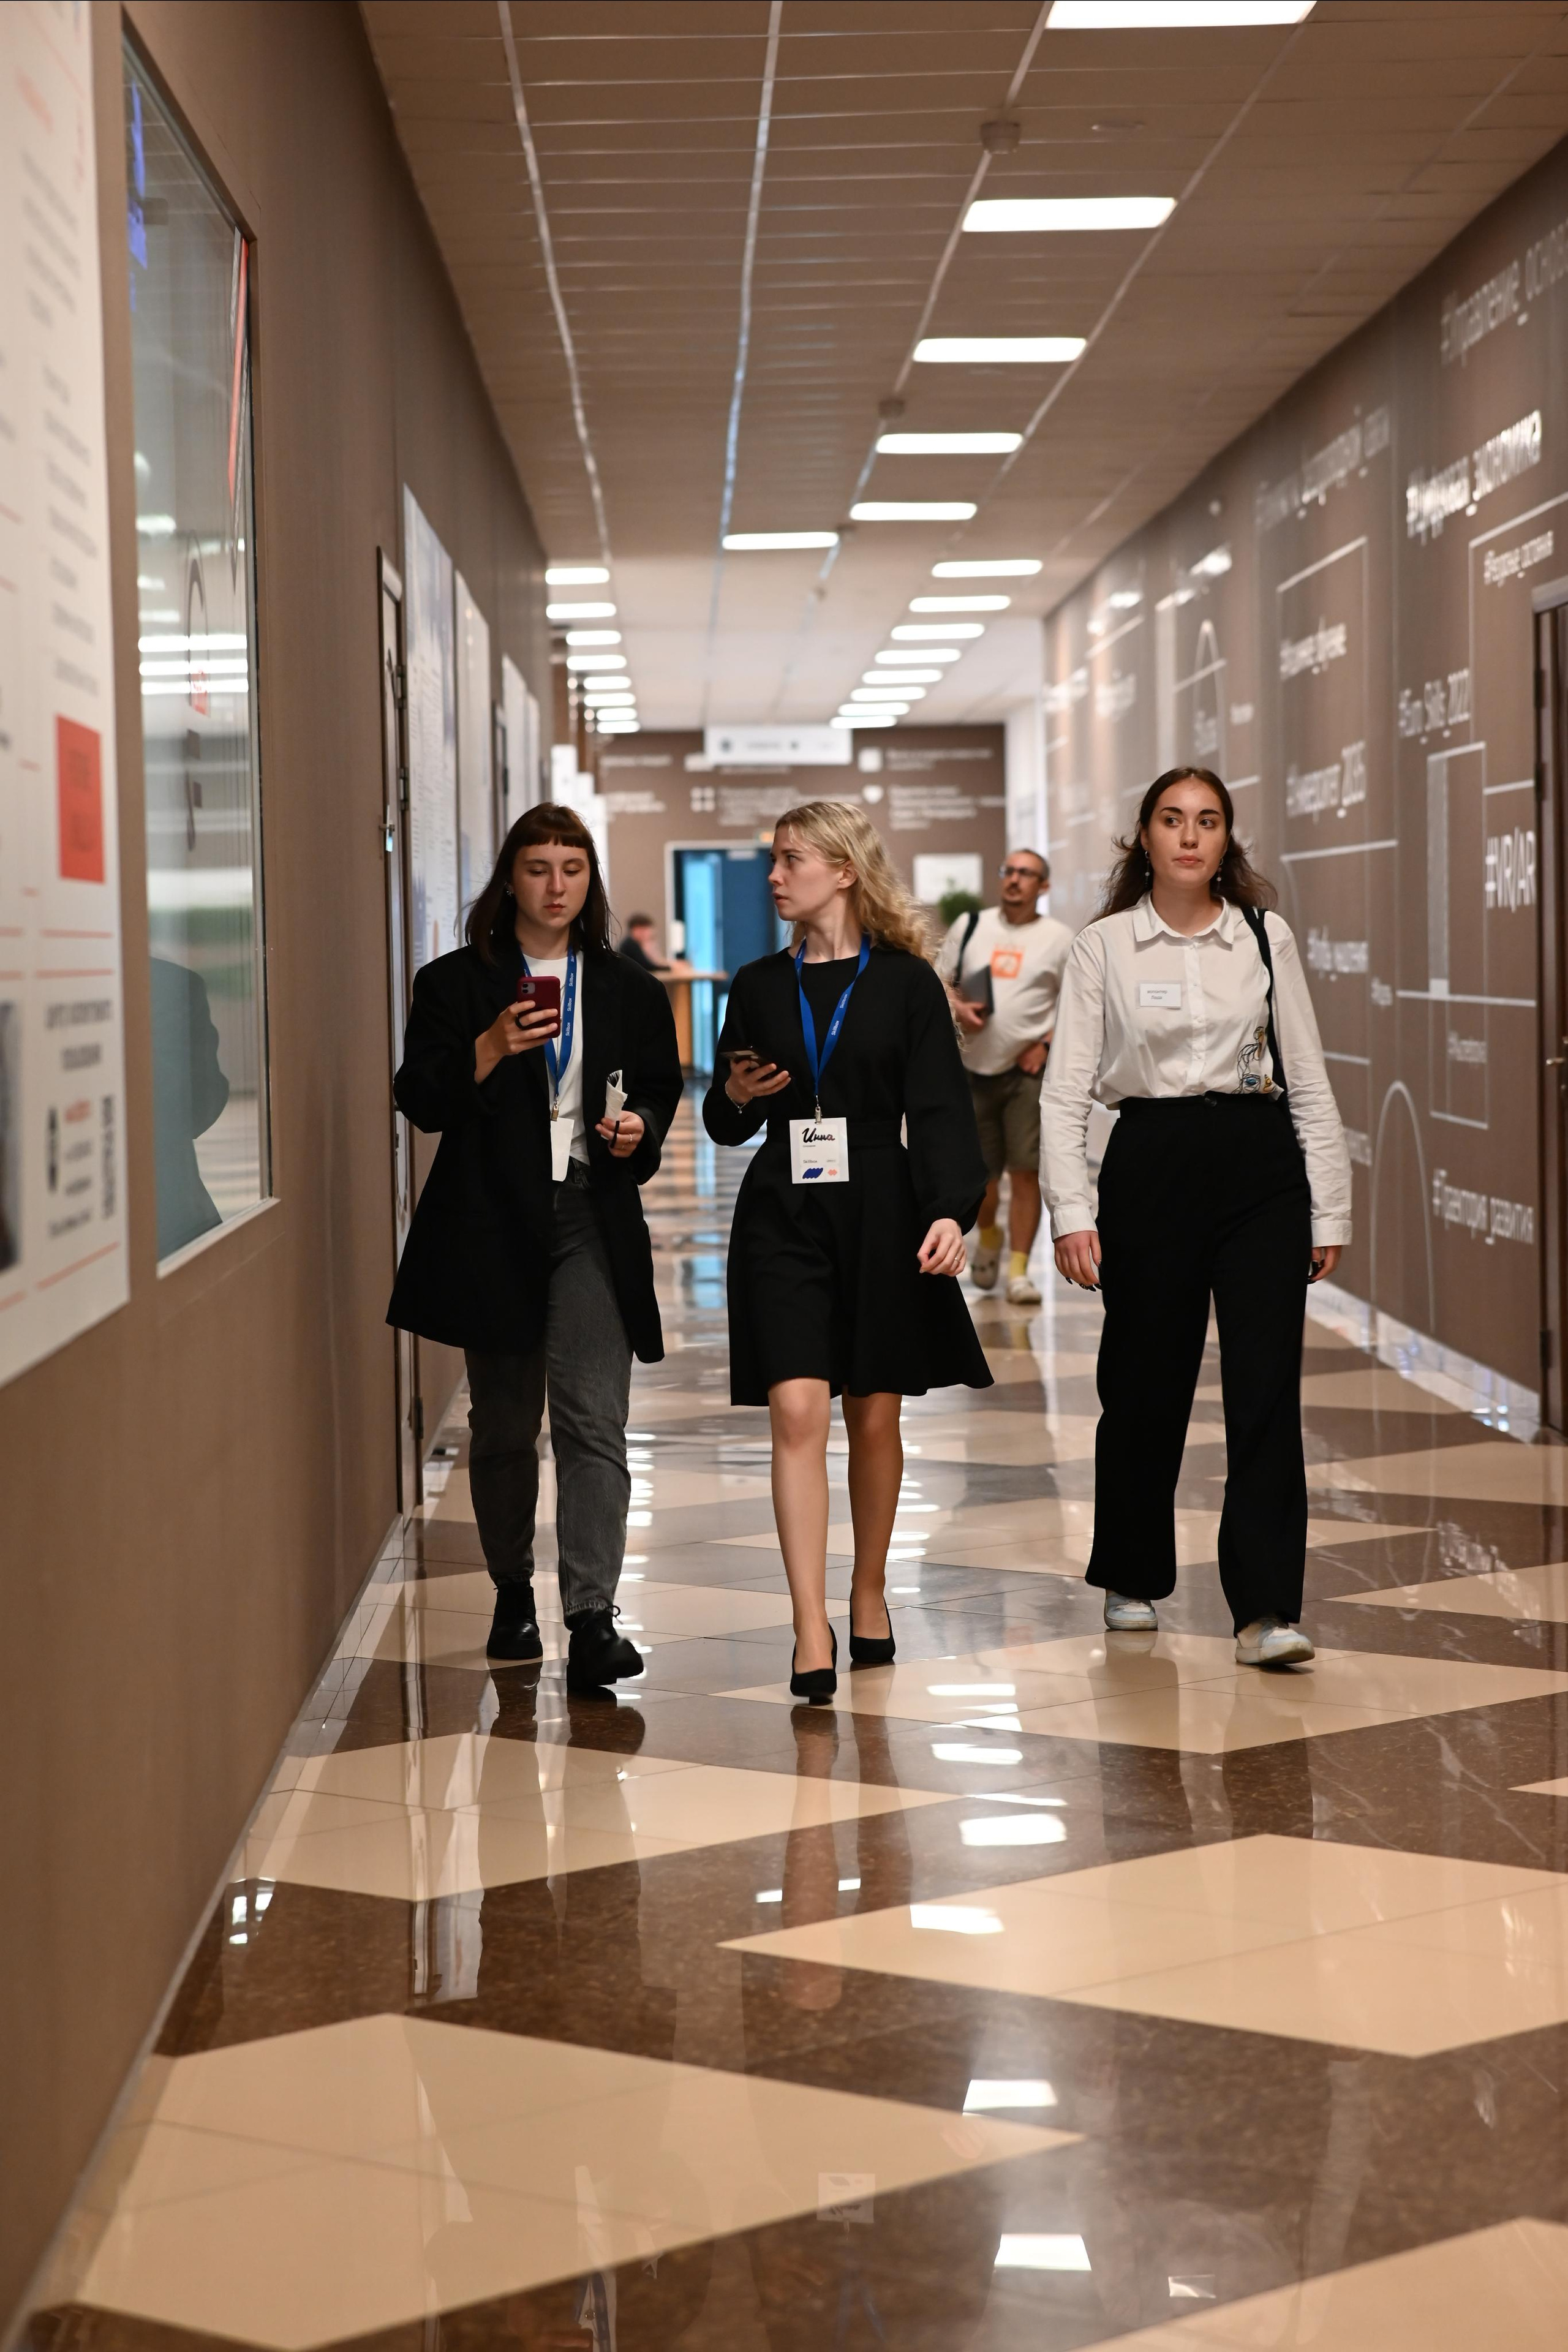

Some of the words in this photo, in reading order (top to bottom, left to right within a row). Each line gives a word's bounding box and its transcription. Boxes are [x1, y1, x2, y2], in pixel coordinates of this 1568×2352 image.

[1485, 826, 1536, 913] #VR/AR
[831, 1020, 840, 1036] Skillbox
[802, 1128, 835, 1143] Инна
